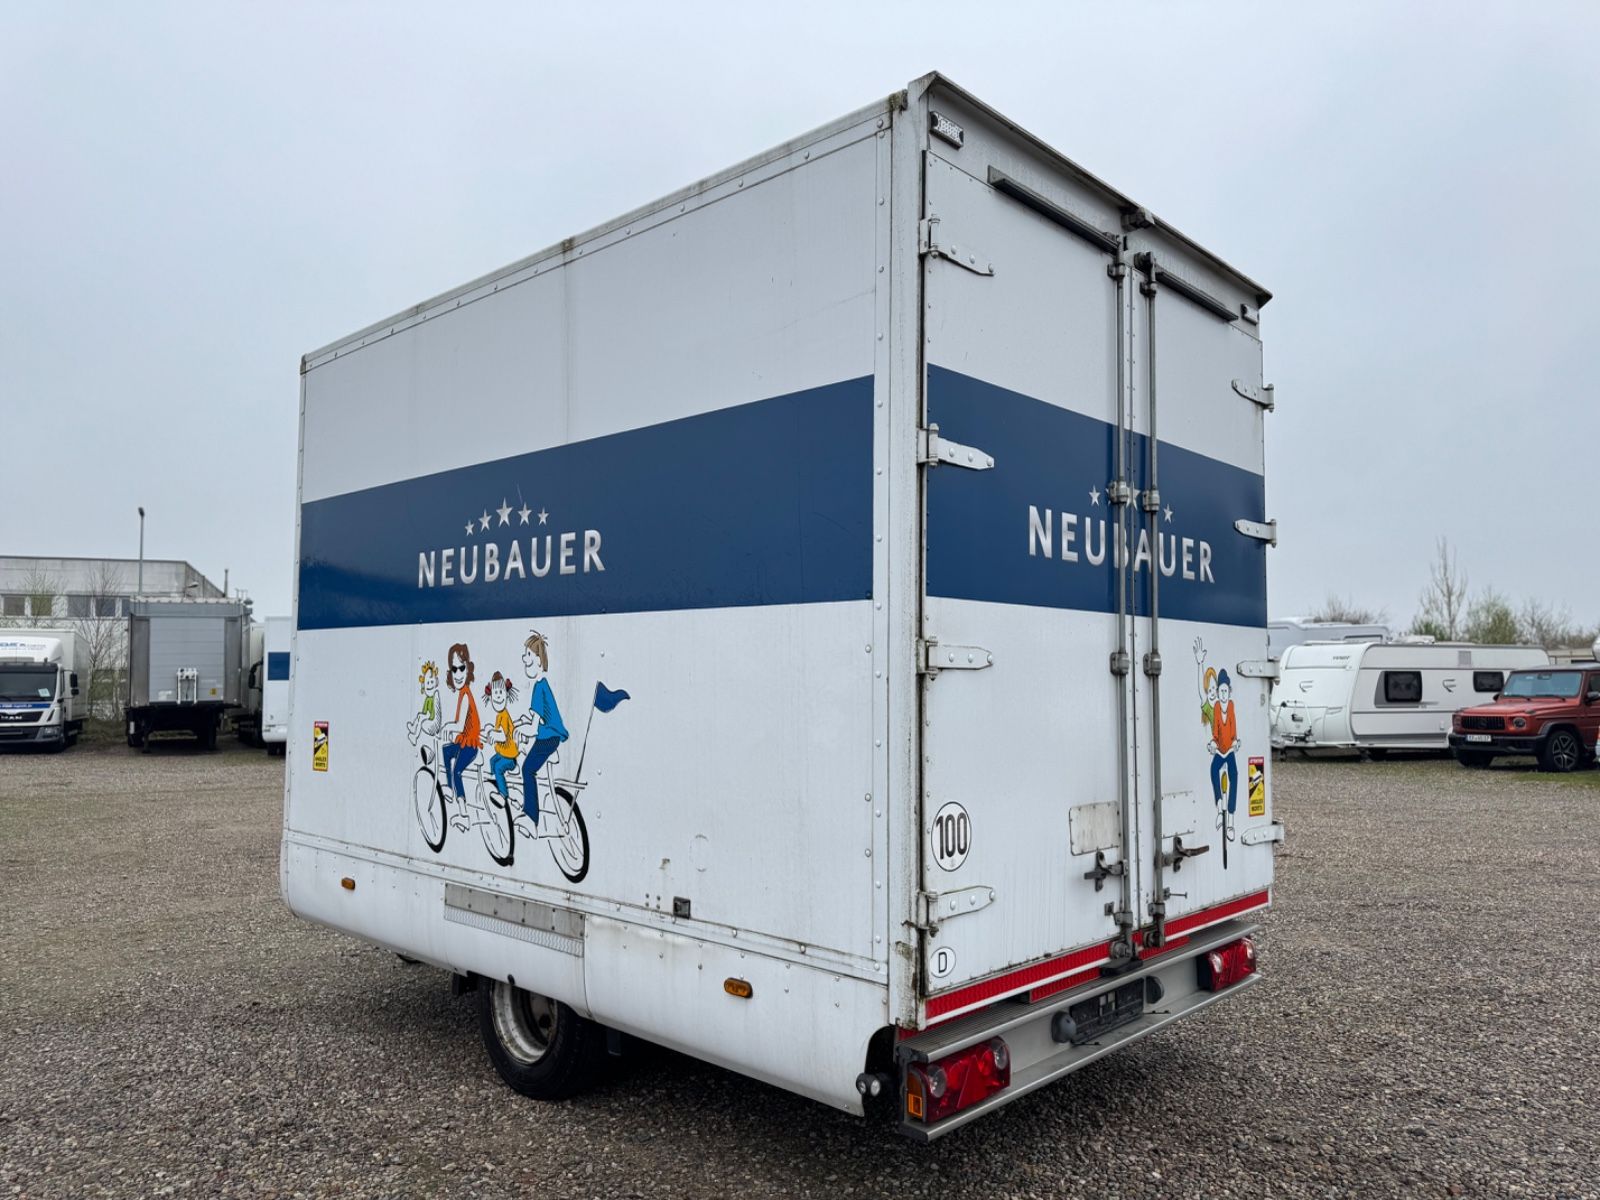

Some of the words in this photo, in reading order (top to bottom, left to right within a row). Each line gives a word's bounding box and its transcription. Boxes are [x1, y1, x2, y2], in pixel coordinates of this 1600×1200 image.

[418, 529, 605, 588] NEUBAUER
[1029, 505, 1215, 583] NEUBAUER
[936, 813, 967, 859] 100
[938, 952, 947, 973] D
